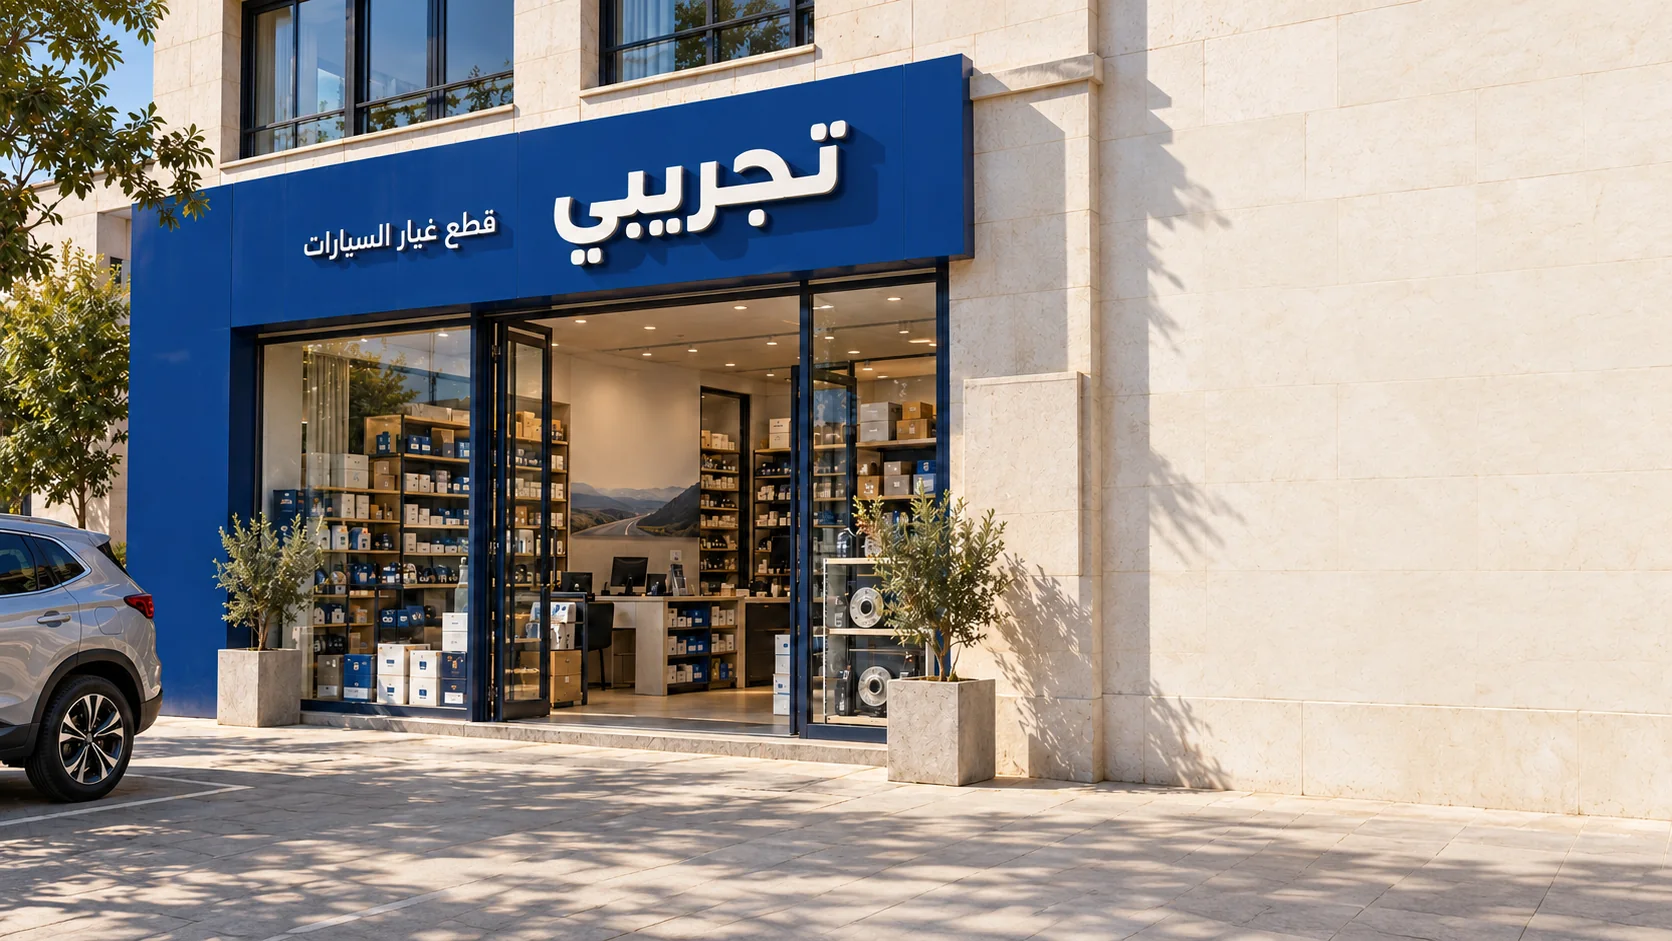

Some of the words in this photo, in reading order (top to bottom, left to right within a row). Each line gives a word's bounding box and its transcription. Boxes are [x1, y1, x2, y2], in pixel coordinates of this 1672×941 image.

[553, 120, 848, 266] تجريبي
[303, 222, 391, 260] السيارات
[396, 218, 438, 251] غيار
[444, 209, 496, 249] قطع
